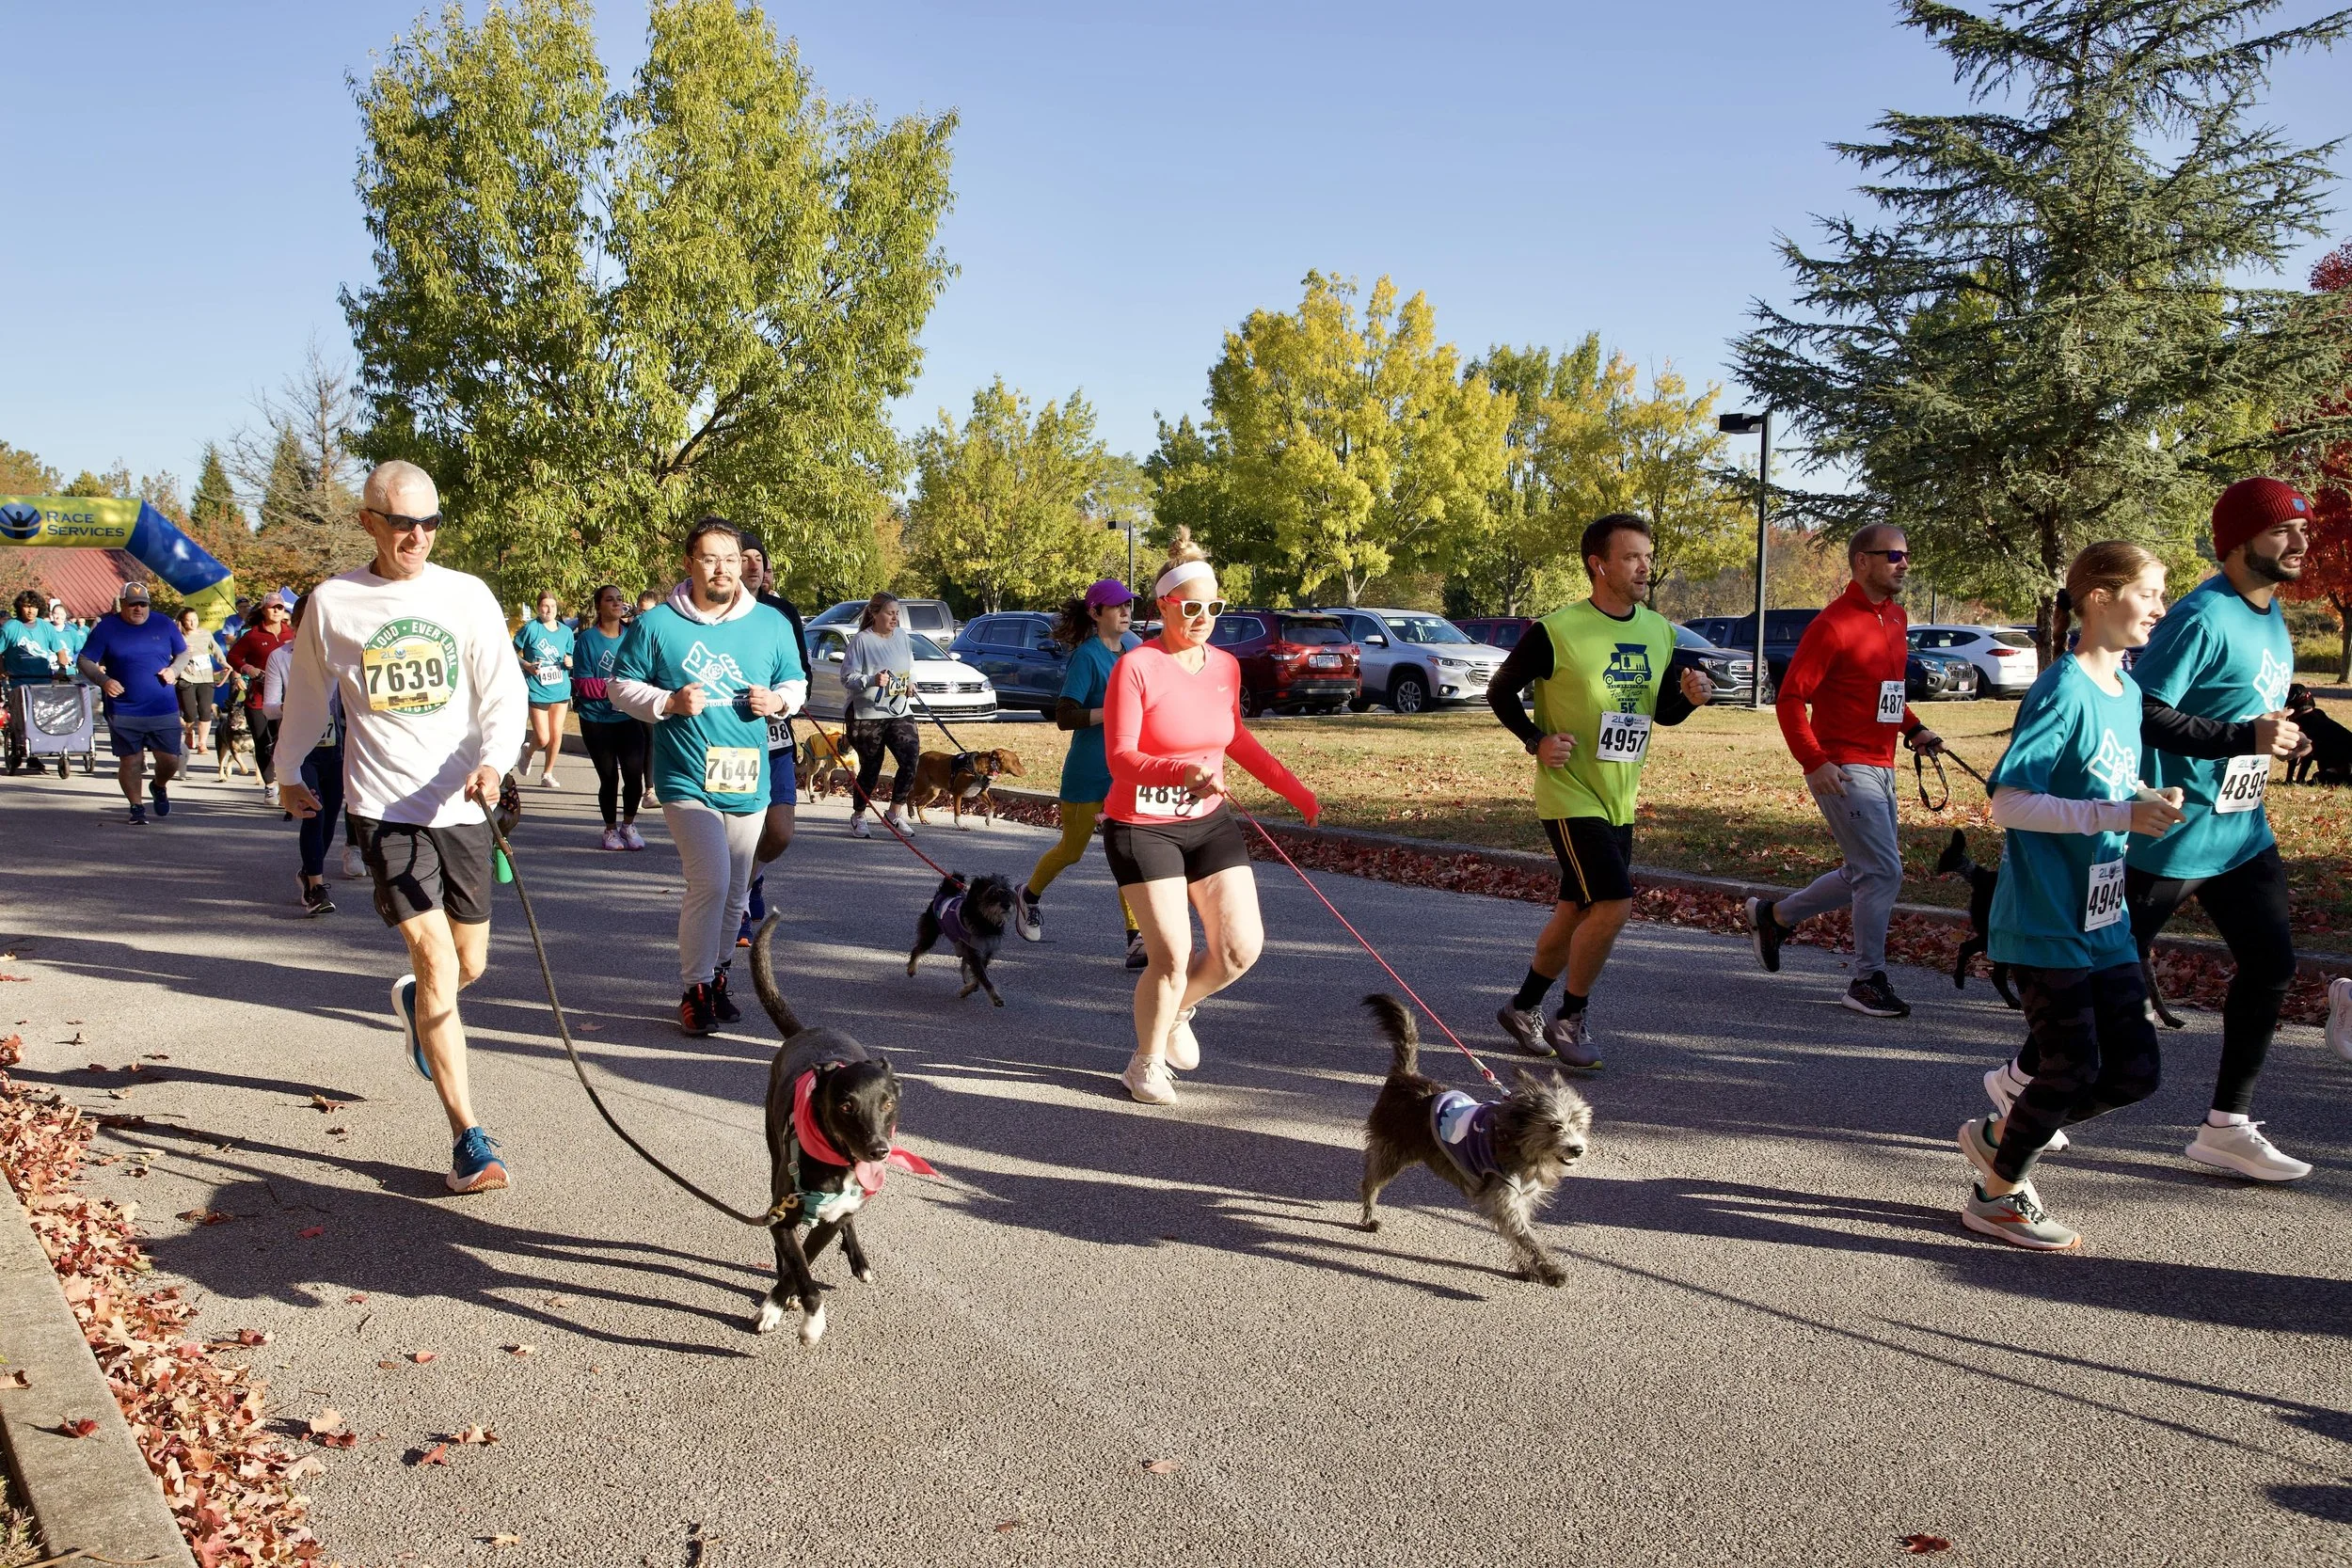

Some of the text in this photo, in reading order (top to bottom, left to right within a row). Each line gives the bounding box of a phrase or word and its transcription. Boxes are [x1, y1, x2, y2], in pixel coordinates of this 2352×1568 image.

[46, 511, 95, 524] RACE
[47, 524, 125, 537] SERVICES
[411, 621, 441, 640] EVER
[440, 635, 457, 669] LOYAL
[366, 657, 444, 694] 7639
[1620, 702, 1637, 713] 5K
[1881, 693, 1904, 714] 487
[767, 723, 789, 742] 98
[1600, 727, 1648, 752] 4957
[707, 758, 758, 781] 7644
[1138, 785, 1184, 805] 489
[2221, 770, 2268, 800] 4895
[2089, 878, 2124, 917] 4949
